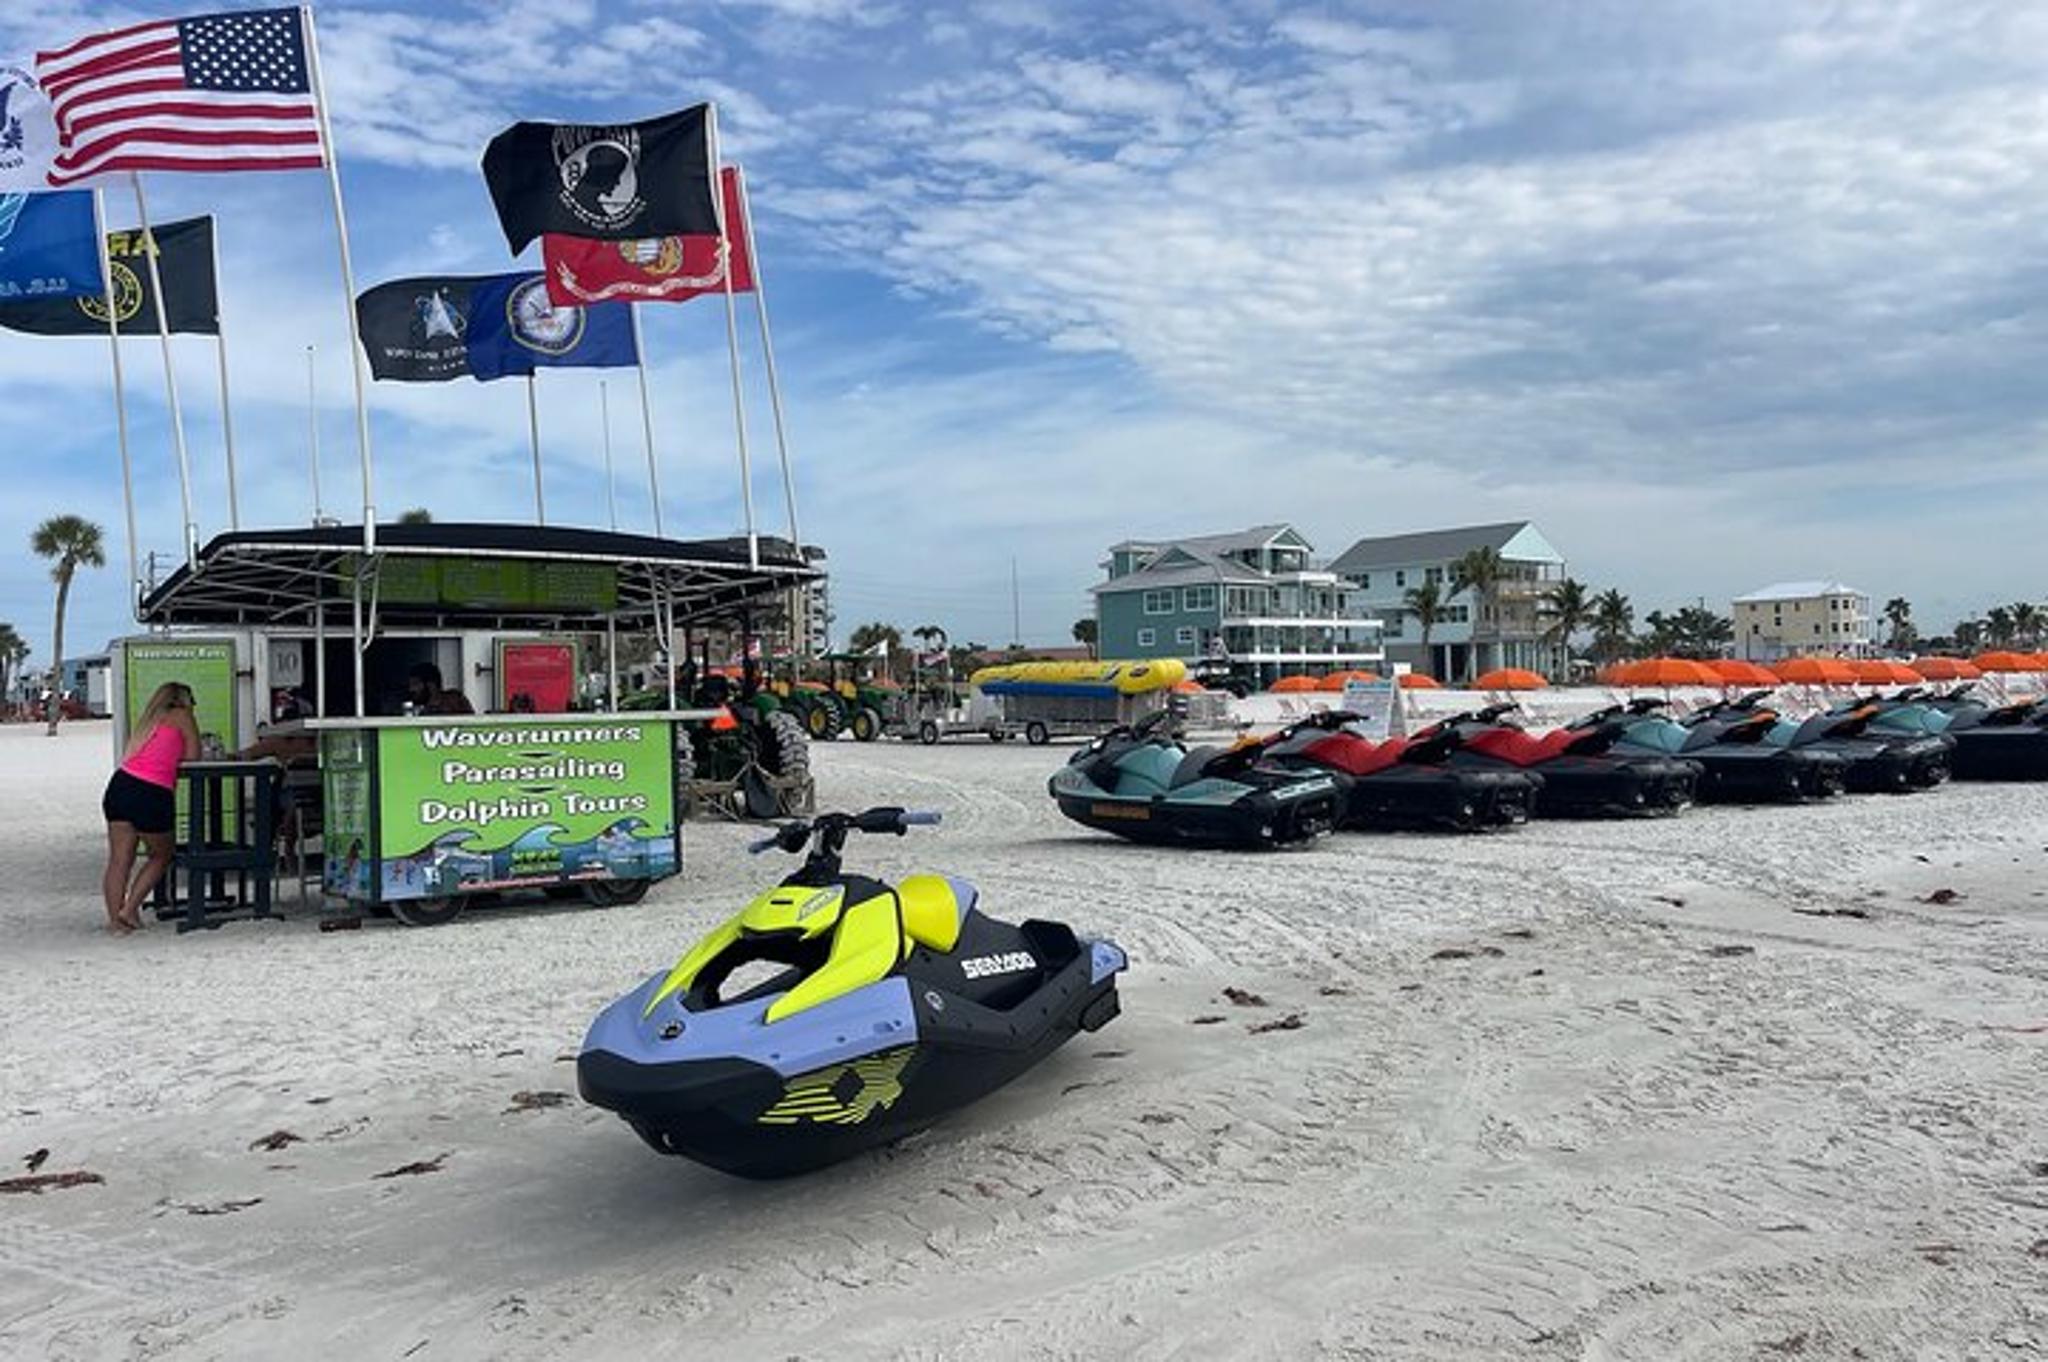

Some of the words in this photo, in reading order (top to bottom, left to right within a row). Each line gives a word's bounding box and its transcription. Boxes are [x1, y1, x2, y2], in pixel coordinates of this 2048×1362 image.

[422, 727, 640, 747] Waverunners
[444, 759, 624, 783] Parasailing
[421, 797, 550, 824] Dolphin
[563, 793, 646, 814] Tours
